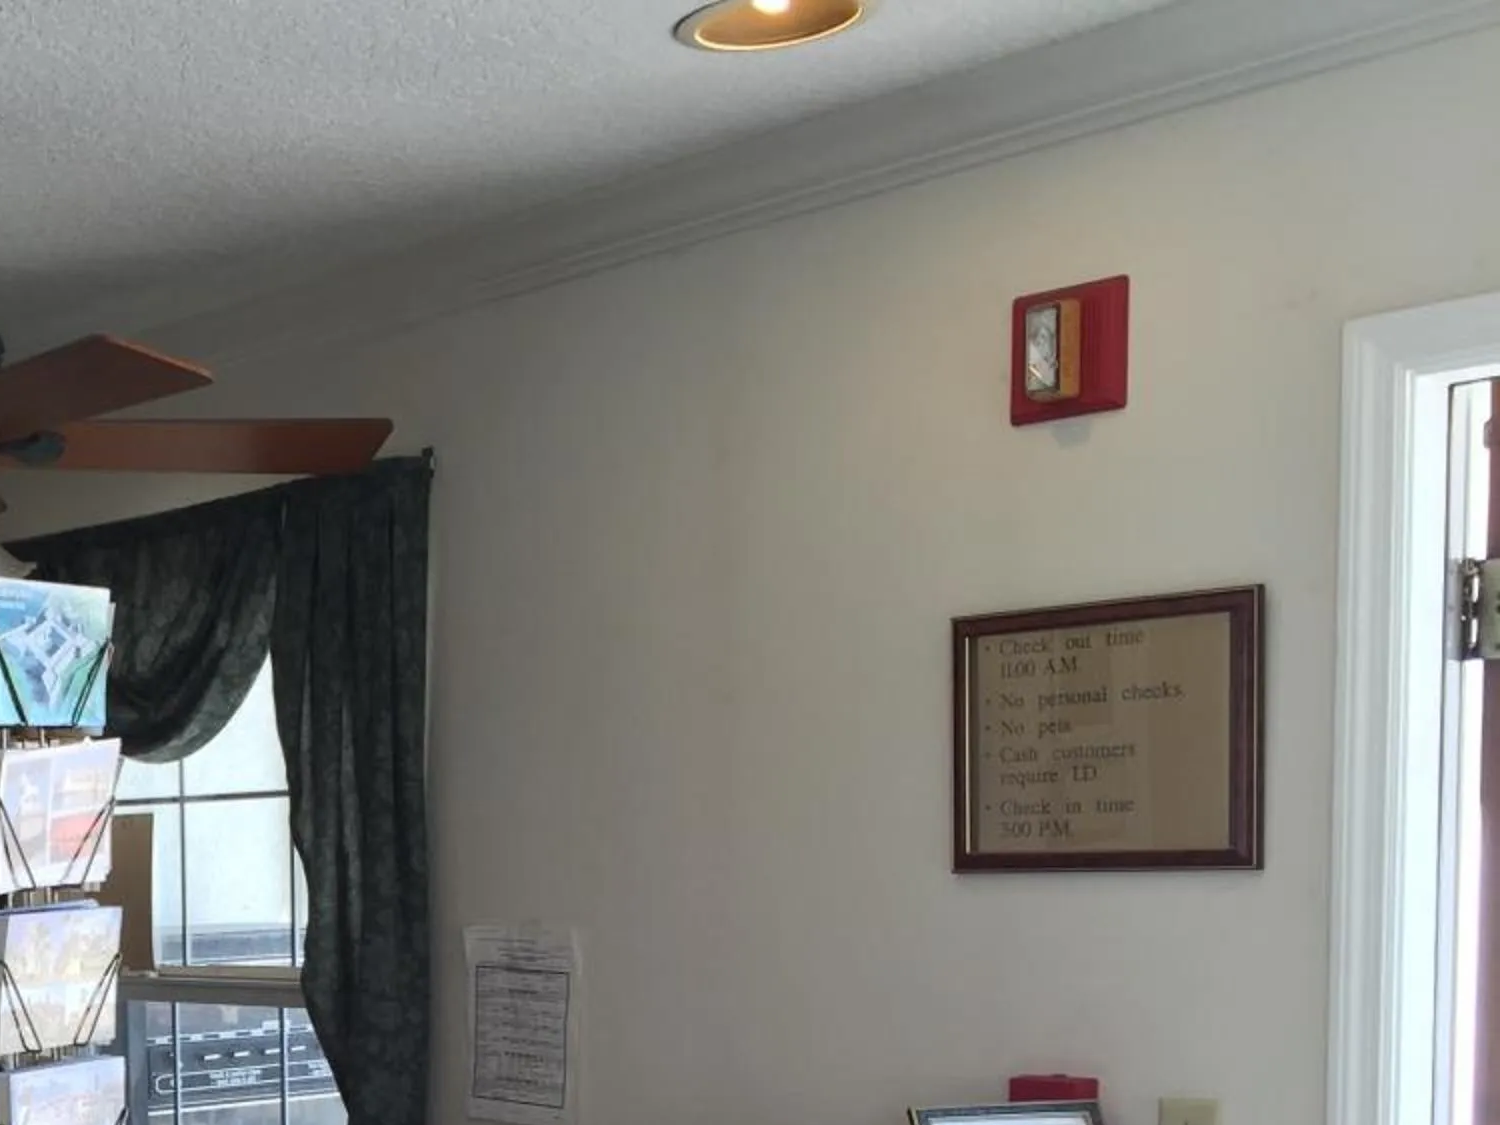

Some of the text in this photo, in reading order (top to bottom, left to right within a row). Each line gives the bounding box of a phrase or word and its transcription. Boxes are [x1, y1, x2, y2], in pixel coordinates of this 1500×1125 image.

[999, 628, 1144, 656] Check out time
[1000, 692, 1025, 709] No
[1038, 685, 1107, 712] personal
[1000, 720, 1025, 738] No
[999, 743, 1136, 764] Cash customers
[1000, 769, 1059, 789] require
[999, 796, 1136, 817] Check in time
